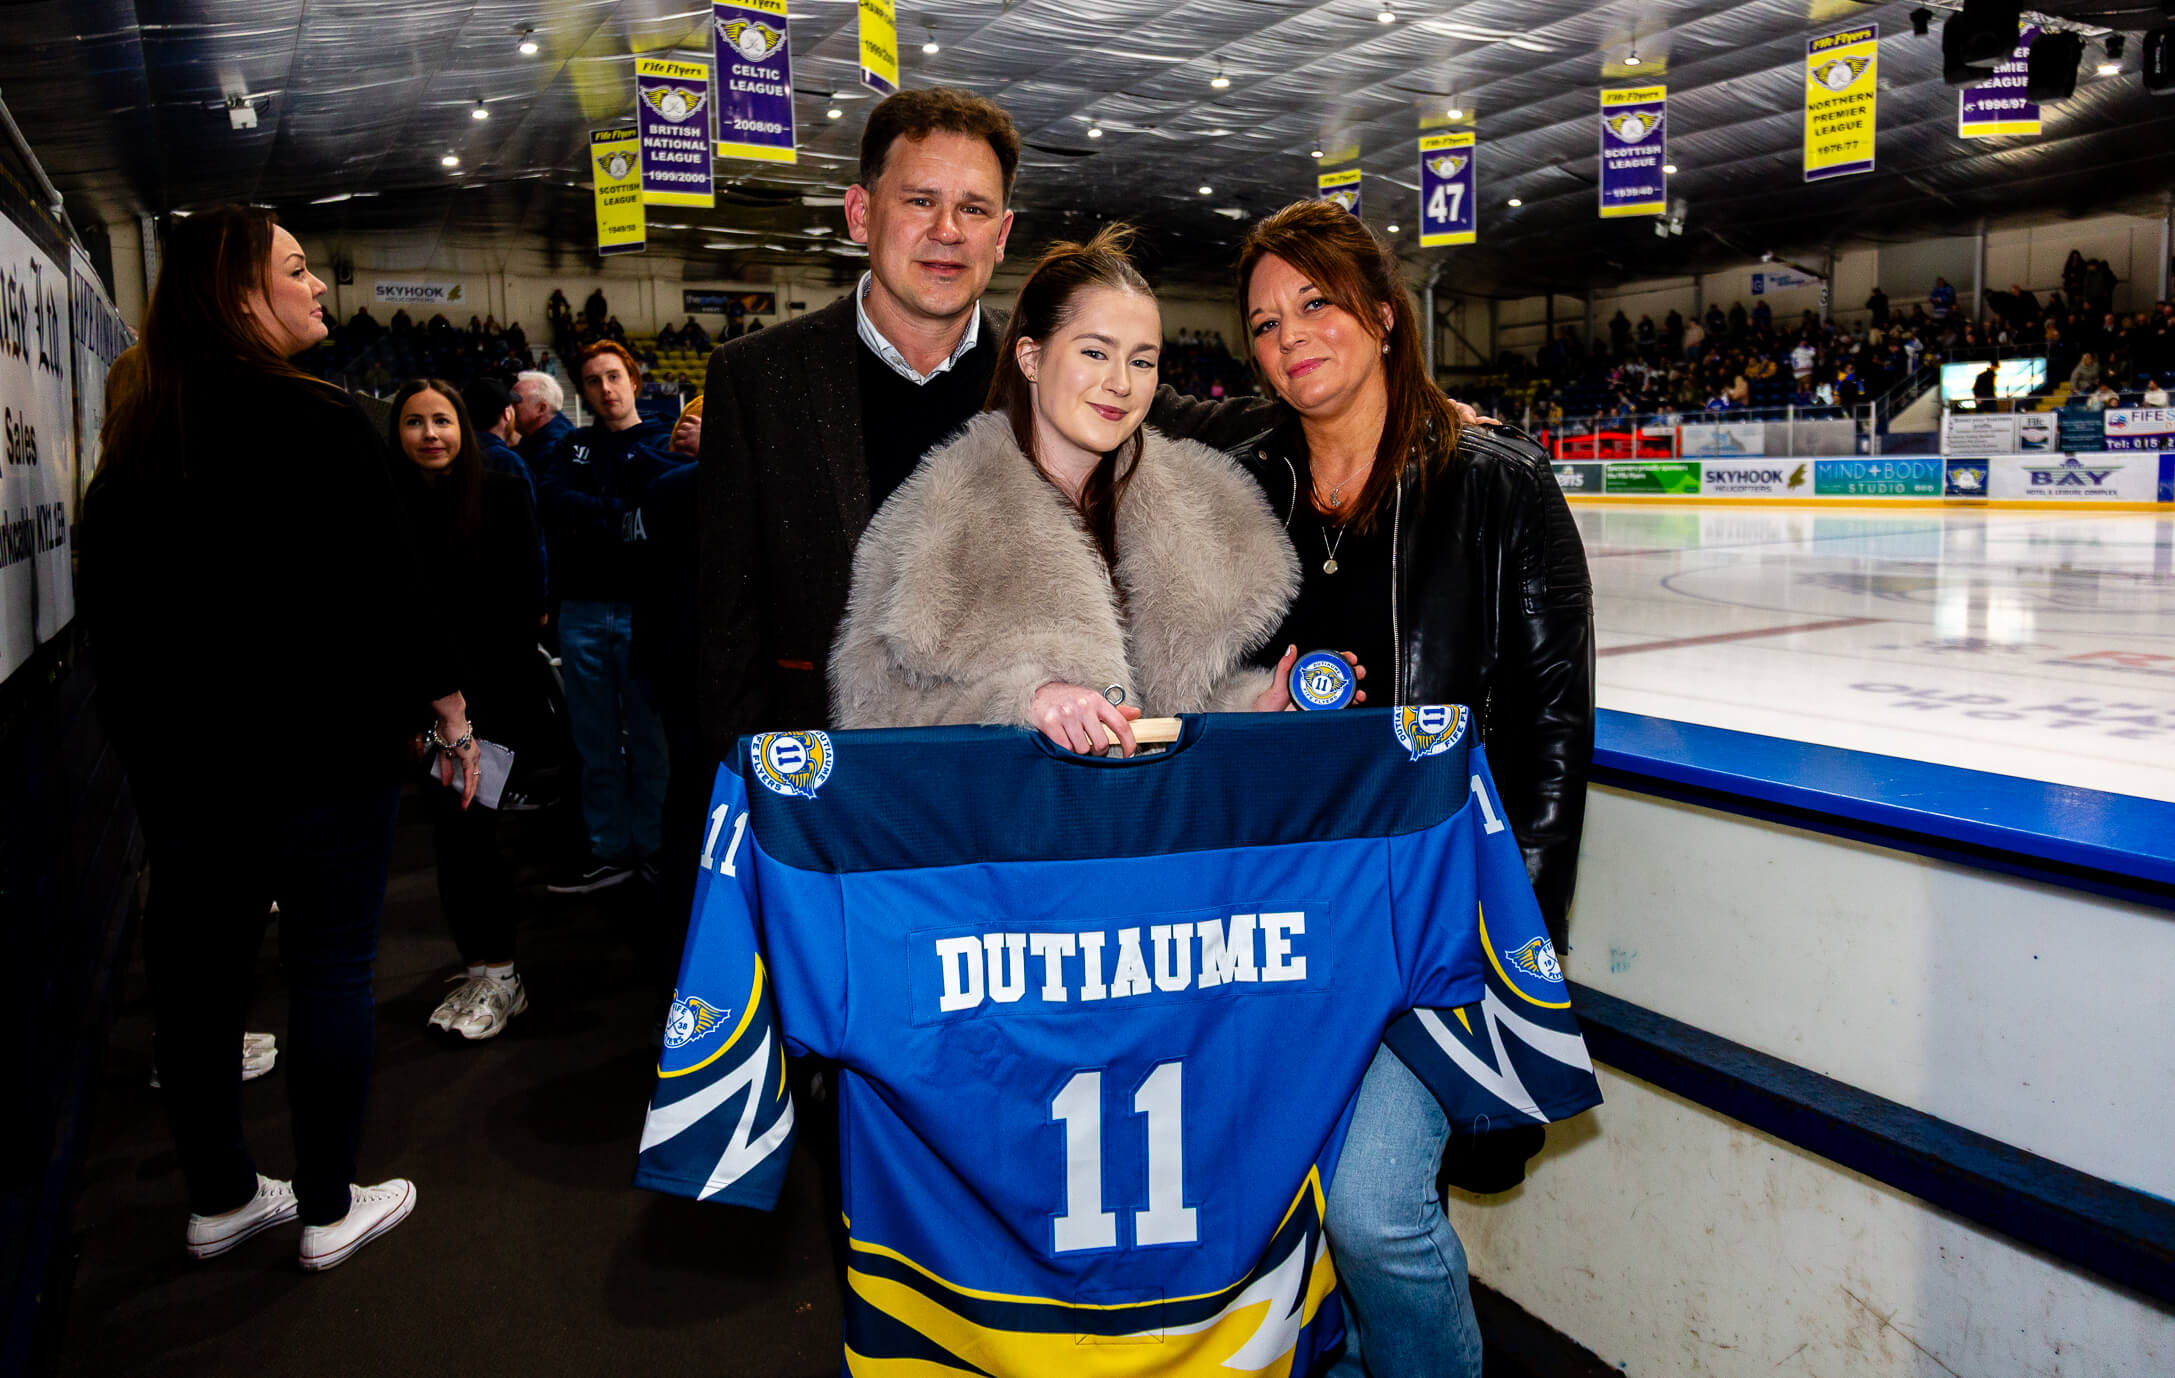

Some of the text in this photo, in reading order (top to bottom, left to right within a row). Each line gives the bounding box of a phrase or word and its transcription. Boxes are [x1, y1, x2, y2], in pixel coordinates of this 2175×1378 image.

[746, 0, 781, 9] yers
[643, 62, 702, 76] Fife Flyers
[732, 64, 780, 80] CELTIC
[1993, 62, 2028, 73] EMIE
[729, 79, 784, 96] LEAGUE
[1808, 91, 1874, 112] NORTHERN
[1813, 106, 1867, 123] PREMIER
[649, 125, 701, 137] BRITISH
[734, 119, 782, 134] 2008/09
[1815, 120, 1864, 136] LEAGUE
[643, 138, 707, 151] NATIONAL
[1604, 145, 1661, 158] SCOTTISH
[651, 151, 702, 163] LEAGUE
[1609, 157, 1656, 170] LEAGUE
[599, 183, 640, 194] SCOTTISH
[603, 195, 637, 206] LEAGUE
[1427, 183, 1465, 223] 47
[376, 286, 444, 297] SKYHOOK
[2132, 411, 2164, 422] FIFE
[5, 406, 37, 466] Sales
[2106, 439, 2130, 449] Tel:
[1706, 470, 1783, 484] SKYHOOK
[2031, 471, 2112, 486] BAY
[1848, 483, 1906, 493] STUDIO
[1315, 678, 1328, 691] 11
[1395, 706, 1406, 741] DUTIA
[1423, 708, 1445, 726] 11
[1444, 725, 1464, 747] FIFE
[776, 744, 801, 766] 11
[753, 754, 782, 791] FLYERS
[701, 803, 749, 877] 11
[935, 911, 1308, 1013] DUTIAUME
[678, 1022, 688, 1030] 38
[1051, 1061, 1199, 1253] 11
